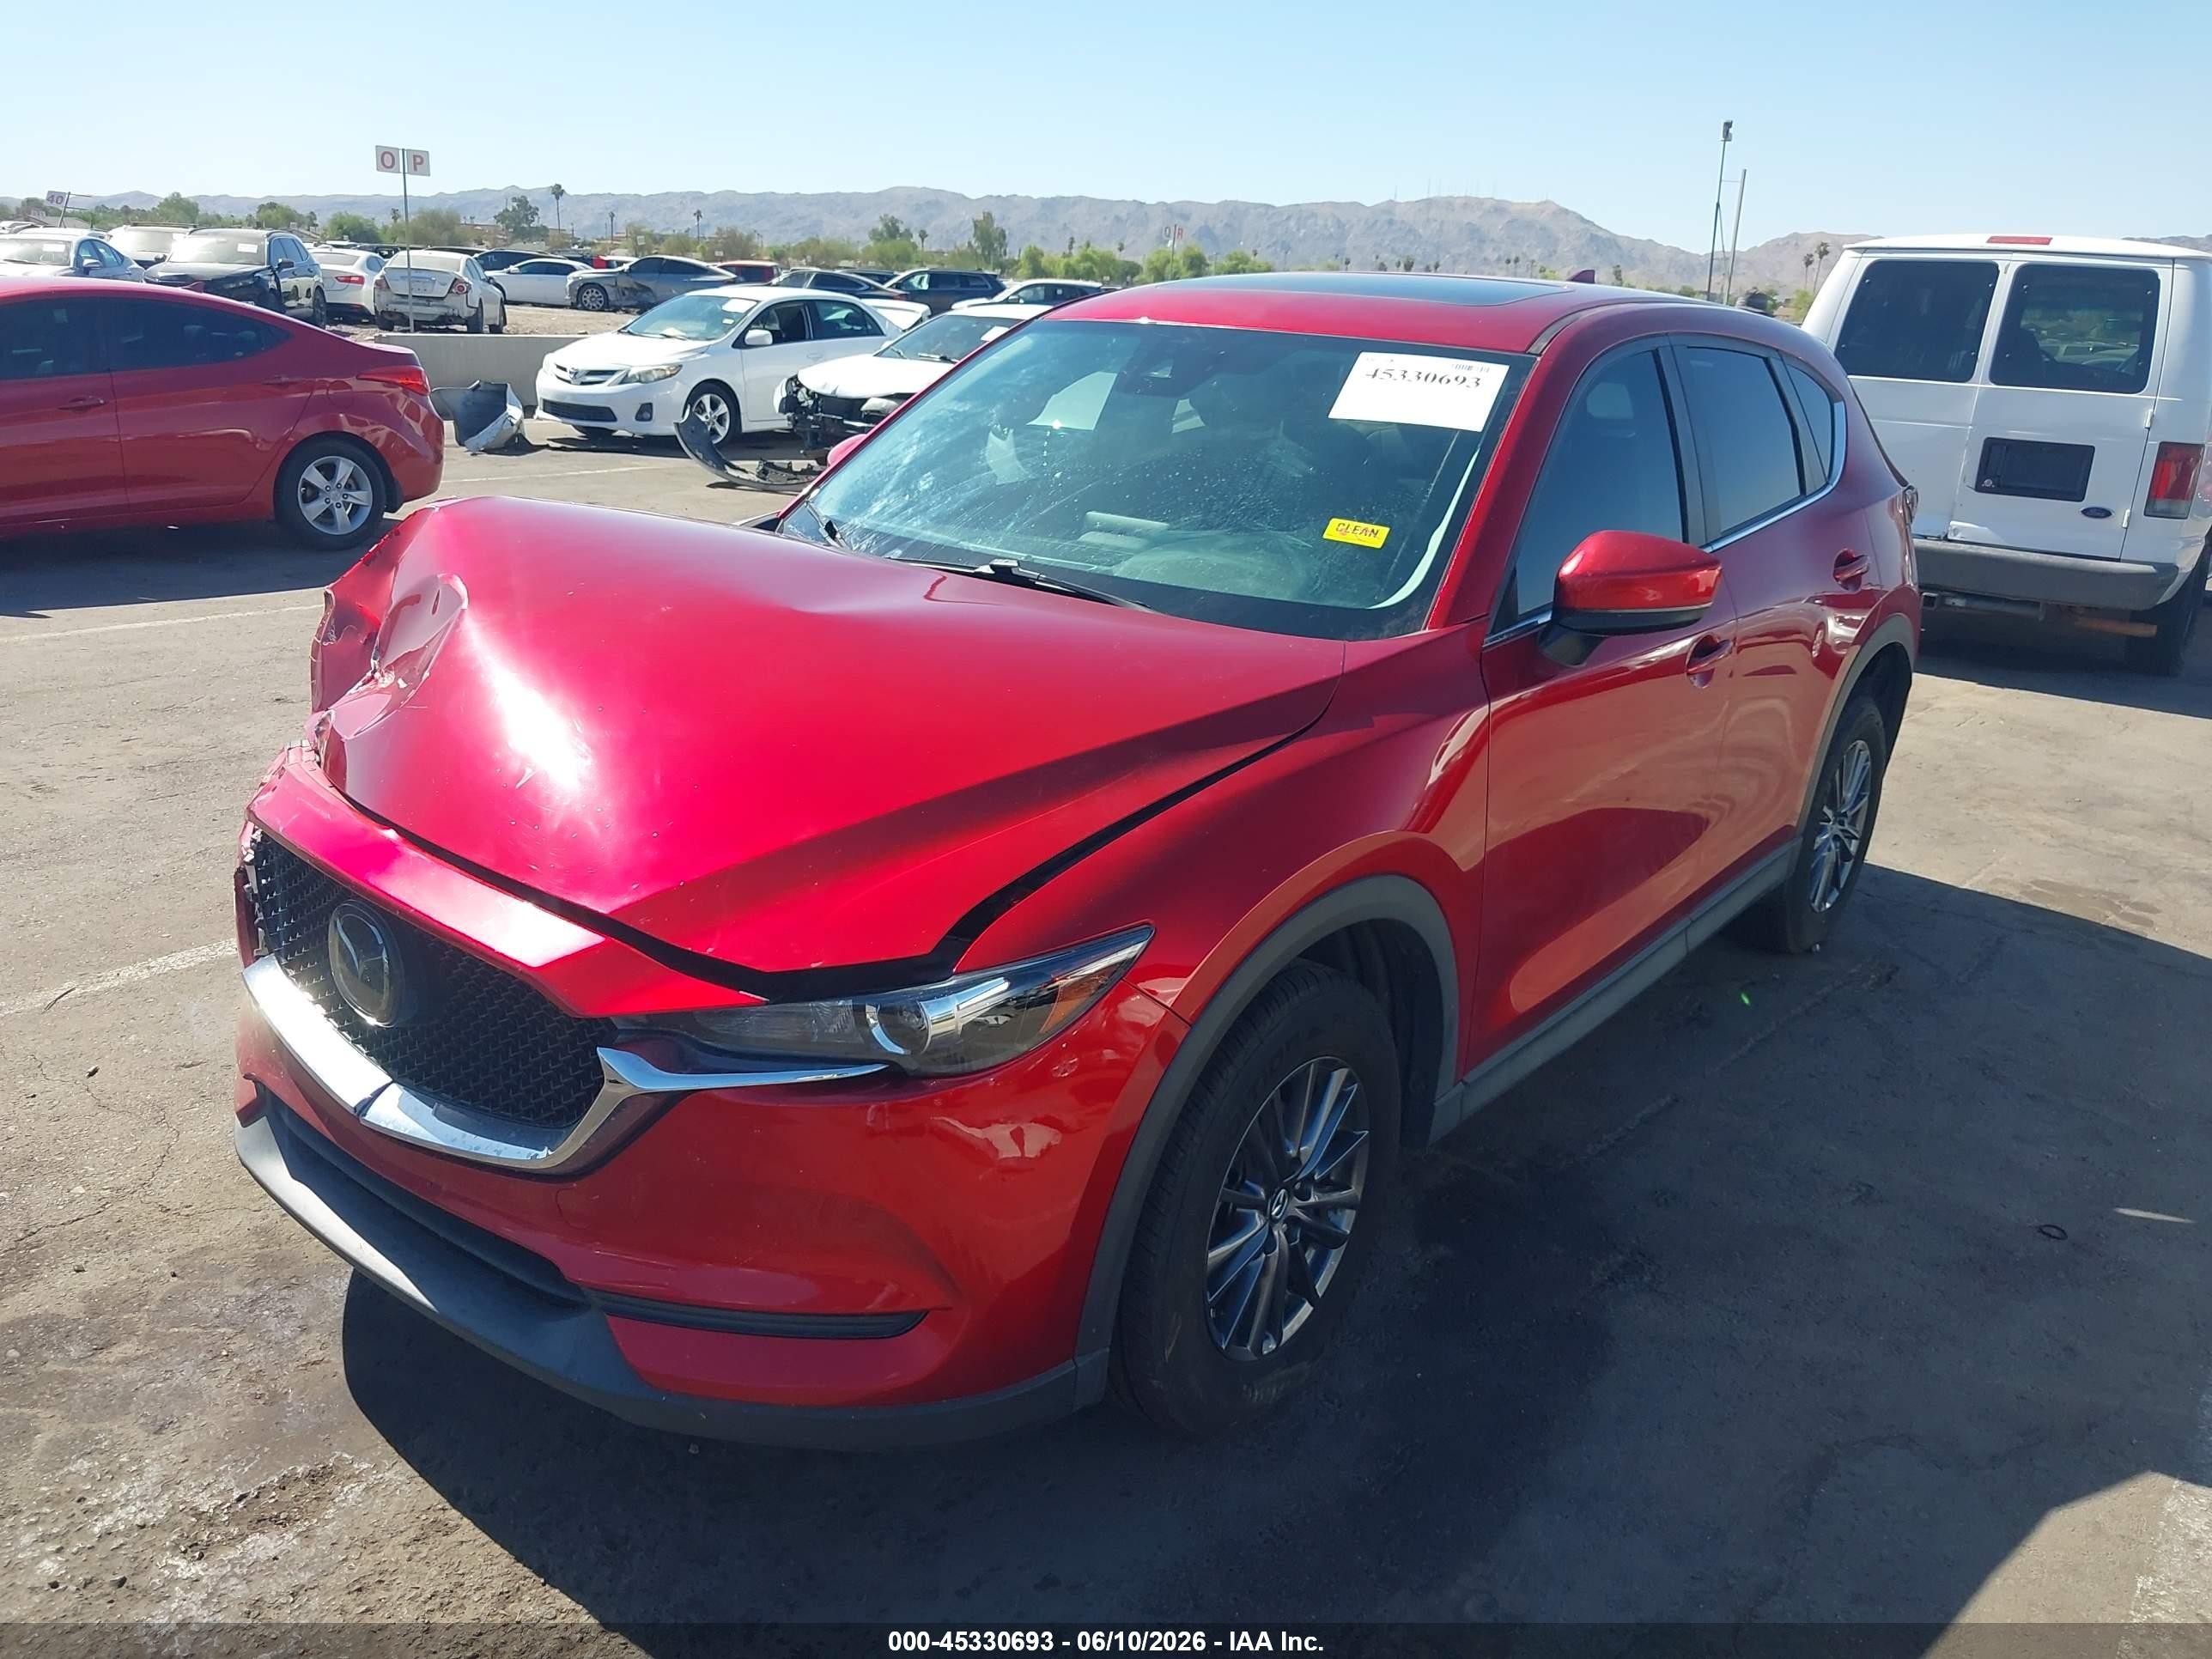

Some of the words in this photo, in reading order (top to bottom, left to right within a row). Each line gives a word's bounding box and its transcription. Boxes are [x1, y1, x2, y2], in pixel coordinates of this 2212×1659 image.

[380, 150, 396, 169] O
[412, 154, 424, 172] P
[46, 194, 64, 205] 40
[1365, 368, 1481, 389] 45330693
[1335, 522, 1379, 538] CLEAN
